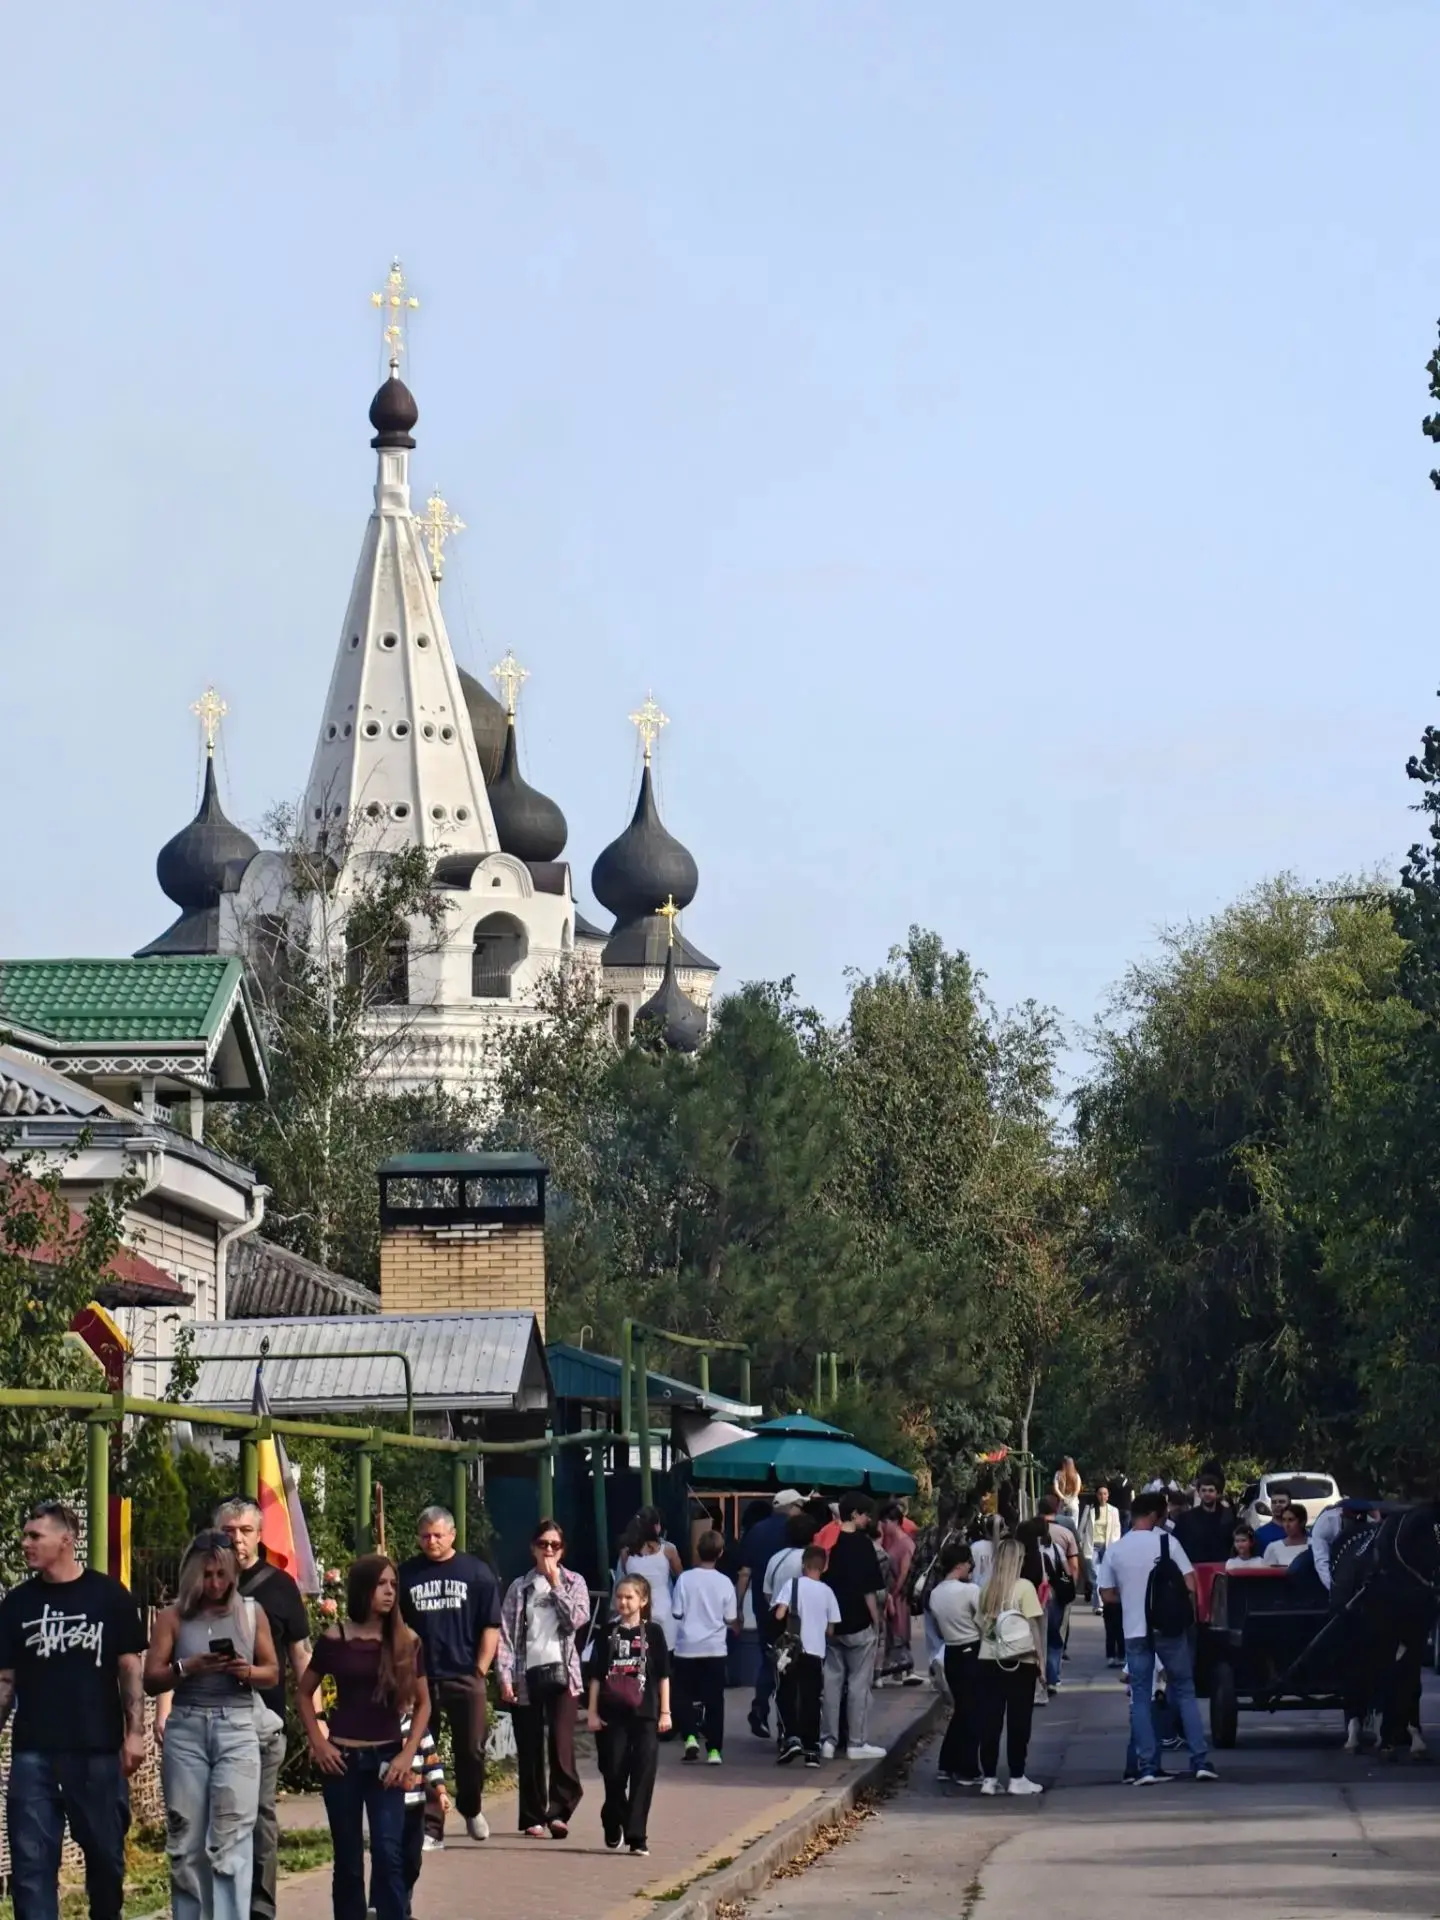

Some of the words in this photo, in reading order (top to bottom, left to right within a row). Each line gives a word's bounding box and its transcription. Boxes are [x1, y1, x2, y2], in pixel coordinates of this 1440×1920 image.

[410, 1580, 442, 1603] TRAIN
[444, 1579, 468, 1600] LIKE
[415, 1597, 462, 1611] CHAMPION
